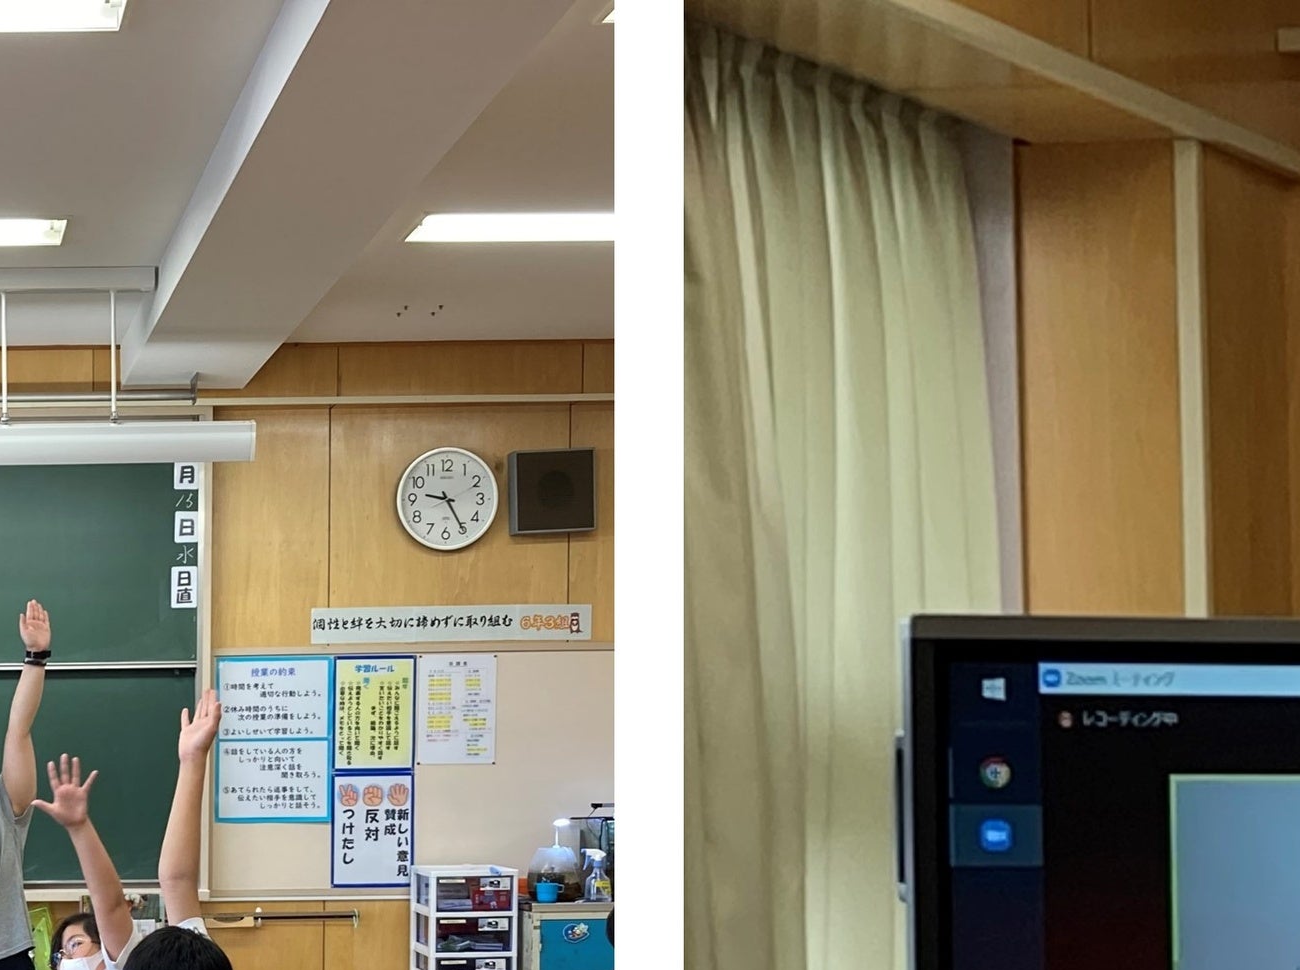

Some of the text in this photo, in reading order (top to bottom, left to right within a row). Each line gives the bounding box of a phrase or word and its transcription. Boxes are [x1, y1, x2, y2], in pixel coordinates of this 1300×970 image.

[426, 464, 435, 476] 11
[441, 459, 454, 472] 12
[463, 463, 467, 476] 1
[179, 465, 195, 484] 月
[472, 475, 481, 487] 2
[412, 476, 425, 489] 10
[408, 493, 417, 506] 9
[476, 492, 485, 505] 3
[412, 510, 422, 523] 8
[470, 510, 479, 522] 4
[179, 518, 195, 536] 日
[426, 523, 435, 535] 7
[441, 527, 450, 540] 6
[458, 522, 467, 535] 5
[176, 570, 193, 604] 日直
[520, 615, 570, 631] 6年3組
[365, 809, 380, 841] 反対
[384, 808, 396, 835] 賛成
[342, 809, 355, 864] つけたし
[397, 808, 409, 877] 新しい意見
